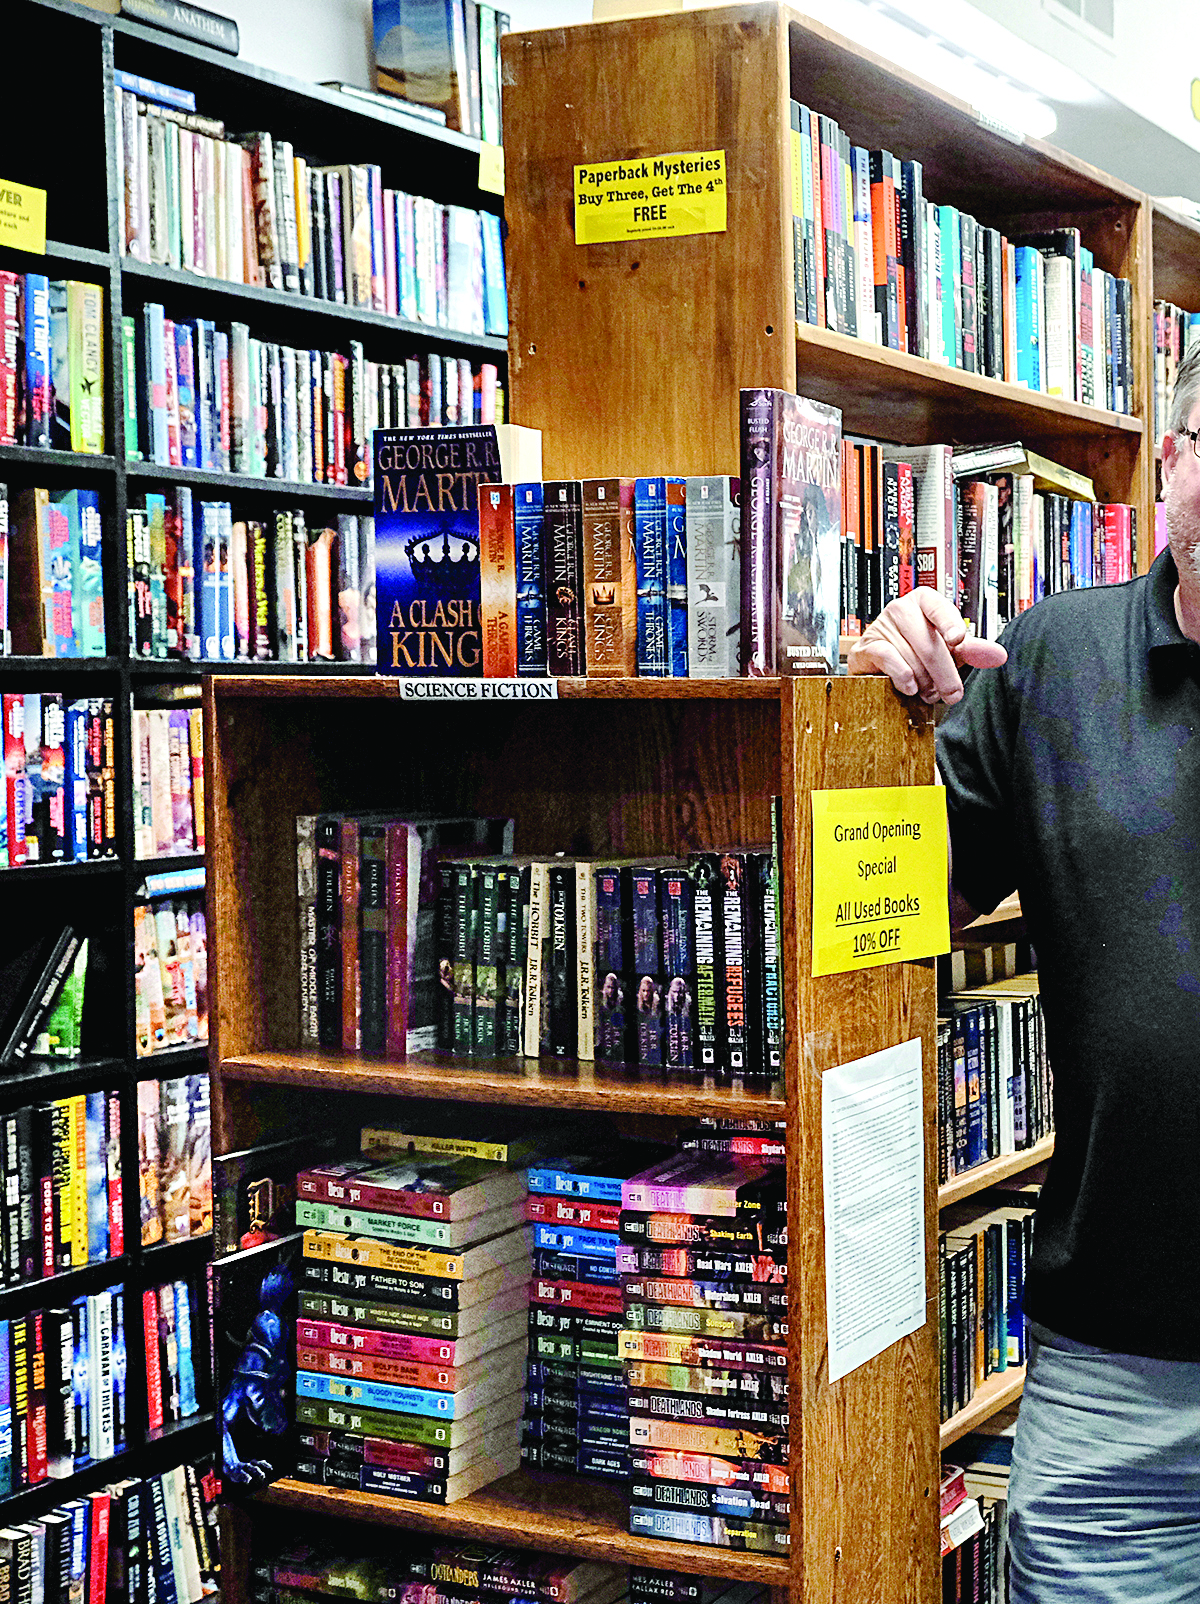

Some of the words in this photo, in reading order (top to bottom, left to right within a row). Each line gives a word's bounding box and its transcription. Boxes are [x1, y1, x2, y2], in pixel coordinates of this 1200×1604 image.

[173, 6, 225, 39] ANATHEM
[579, 163, 649, 187] Paperback
[653, 156, 721, 181] Mysteries
[578, 194, 604, 207] Buy
[607, 190, 649, 202] Three,
[651, 186, 675, 198] Get
[677, 183, 703, 195] The
[633, 204, 667, 222] FREE
[84, 291, 97, 320] TOM
[84, 323, 98, 374] CLANCY
[458, 431, 493, 439] BESTSELLER
[783, 420, 819, 450] GEORGE
[378, 443, 461, 471] GEORGE
[782, 447, 839, 487] MARTIN
[887, 477, 895, 520] NADEL
[905, 470, 914, 525] BARBARA
[522, 526, 533, 582] MARTIN
[554, 524, 566, 581] MARTIN
[593, 522, 605, 580] MARTIN
[642, 521, 656, 578] MARTIN
[694, 522, 706, 580] MARTIN
[388, 600, 405, 627] A
[409, 600, 473, 627] CLASH
[556, 618, 566, 659] KINGS
[594, 613, 605, 661] KINGS
[645, 612, 656, 660] THRONES
[697, 611, 707, 662] SWORDS
[708, 616, 717, 655] STORM
[787, 646, 811, 657] BUSTED
[405, 682, 477, 698] SCIENCE
[481, 683, 553, 698] FICTION
[15, 778, 26, 842] CORSAIR
[834, 822, 869, 842] Grand
[873, 819, 921, 842] Opening
[858, 856, 897, 880] Special
[532, 882, 540, 898] The
[836, 902, 851, 922] All
[855, 897, 881, 919] Used
[885, 894, 920, 915] Books
[530, 903, 540, 949] HOBBIT
[554, 902, 566, 950] TOLKIEN
[694, 896, 714, 964] REMAINING
[724, 897, 742, 965] REMAINING
[854, 931, 877, 953] 10%
[879, 928, 900, 949] OFF
[309, 964, 318, 1002] MIDDLE
[696, 965, 715, 1026] AFTERMATH
[726, 966, 744, 1027] REFUGEES
[310, 1006, 318, 1038] EARTH
[669, 1024, 678, 1061] TOLKIEN
[432, 1143, 454, 1151] KILLER
[702, 1140, 754, 1154] DEATHLANDS
[761, 1144, 787, 1155] Skydark
[43, 1181, 53, 1215] CODE
[744, 1201, 762, 1209] Zone
[45, 1217, 53, 1232] TO
[368, 1217, 396, 1230] MARKET
[397, 1221, 421, 1232] FORCE
[647, 1221, 701, 1242] DEATHLANDS
[710, 1229, 735, 1240] Shaking
[736, 1231, 753, 1240] Earth
[44, 1235, 53, 1267] ZERO
[392, 1249, 405, 1257] END
[579, 1235, 596, 1243] FADE
[598, 1237, 607, 1245] TO
[386, 1256, 420, 1267] BEGINNING
[697, 1259, 712, 1269] Road
[714, 1260, 731, 1271] Wars
[735, 1262, 753, 1273] AXLER
[371, 1275, 397, 1286] FATHER
[398, 1279, 407, 1287] TO
[409, 1280, 424, 1289] SON
[647, 1282, 700, 1302] DEATHLANDS
[743, 1293, 761, 1304] AXLER
[585, 1319, 611, 1328] EMINENT
[647, 1309, 700, 1330] DEATHLANDS
[706, 1318, 734, 1330] Sunspot
[14, 1322, 27, 1346] THE
[100, 1328, 110, 1378] CARAVAN
[724, 1351, 742, 1361] World
[746, 1352, 764, 1363] AXLER
[15, 1348, 28, 1416] INFORMANT
[33, 1352, 45, 1390] PERRY
[401, 1366, 419, 1375] BANE
[367, 1388, 392, 1398] BLOODY
[394, 1391, 424, 1402] TOURISTS
[650, 1396, 704, 1418] DEATHLANDS
[752, 1412, 767, 1421] AXLER
[101, 1388, 112, 1434] THIEVES
[373, 1471, 386, 1479] HOLY
[388, 1473, 411, 1482] MOTHER
[591, 1458, 605, 1466] DARK
[607, 1460, 621, 1468] AGES
[654, 1458, 706, 1479] DEATHLANDS
[655, 1485, 709, 1507] DEATHLANDS
[712, 1493, 747, 1506] Salvation
[751, 1499, 770, 1510] Road
[655, 1516, 708, 1537] DEATHLANDS
[724, 1527, 757, 1539] Separation
[17, 1540, 31, 1581] BRAD
[431, 1563, 479, 1588] OUTLANDERS
[483, 1574, 508, 1584] JAMES
[510, 1578, 536, 1588] AXLER
[649, 1578, 674, 1588] AXLER
[660, 1588, 674, 1597] RED
